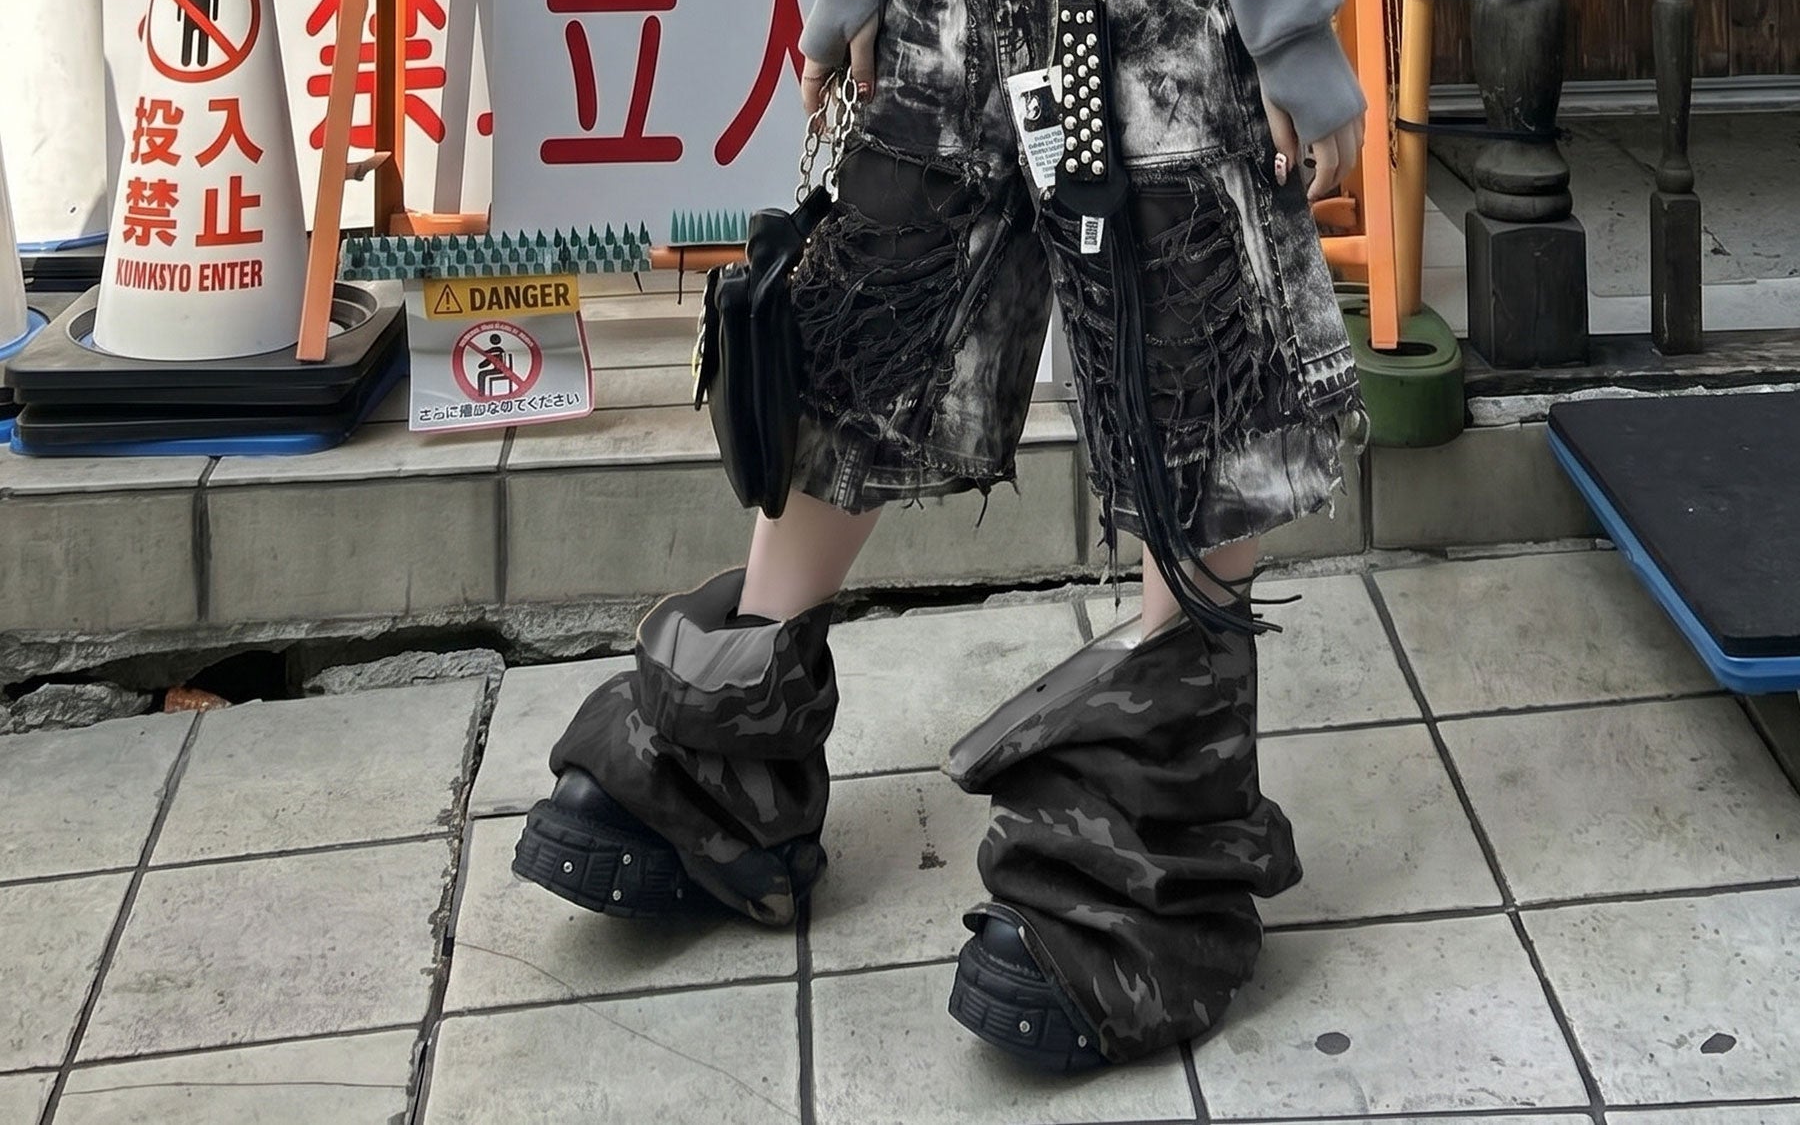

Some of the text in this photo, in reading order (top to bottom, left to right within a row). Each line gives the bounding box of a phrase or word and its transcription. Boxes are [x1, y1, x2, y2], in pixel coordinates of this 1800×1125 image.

[123, 176, 263, 247] 禁止
[199, 259, 262, 292] ENTER
[469, 283, 571, 312] DANGER
